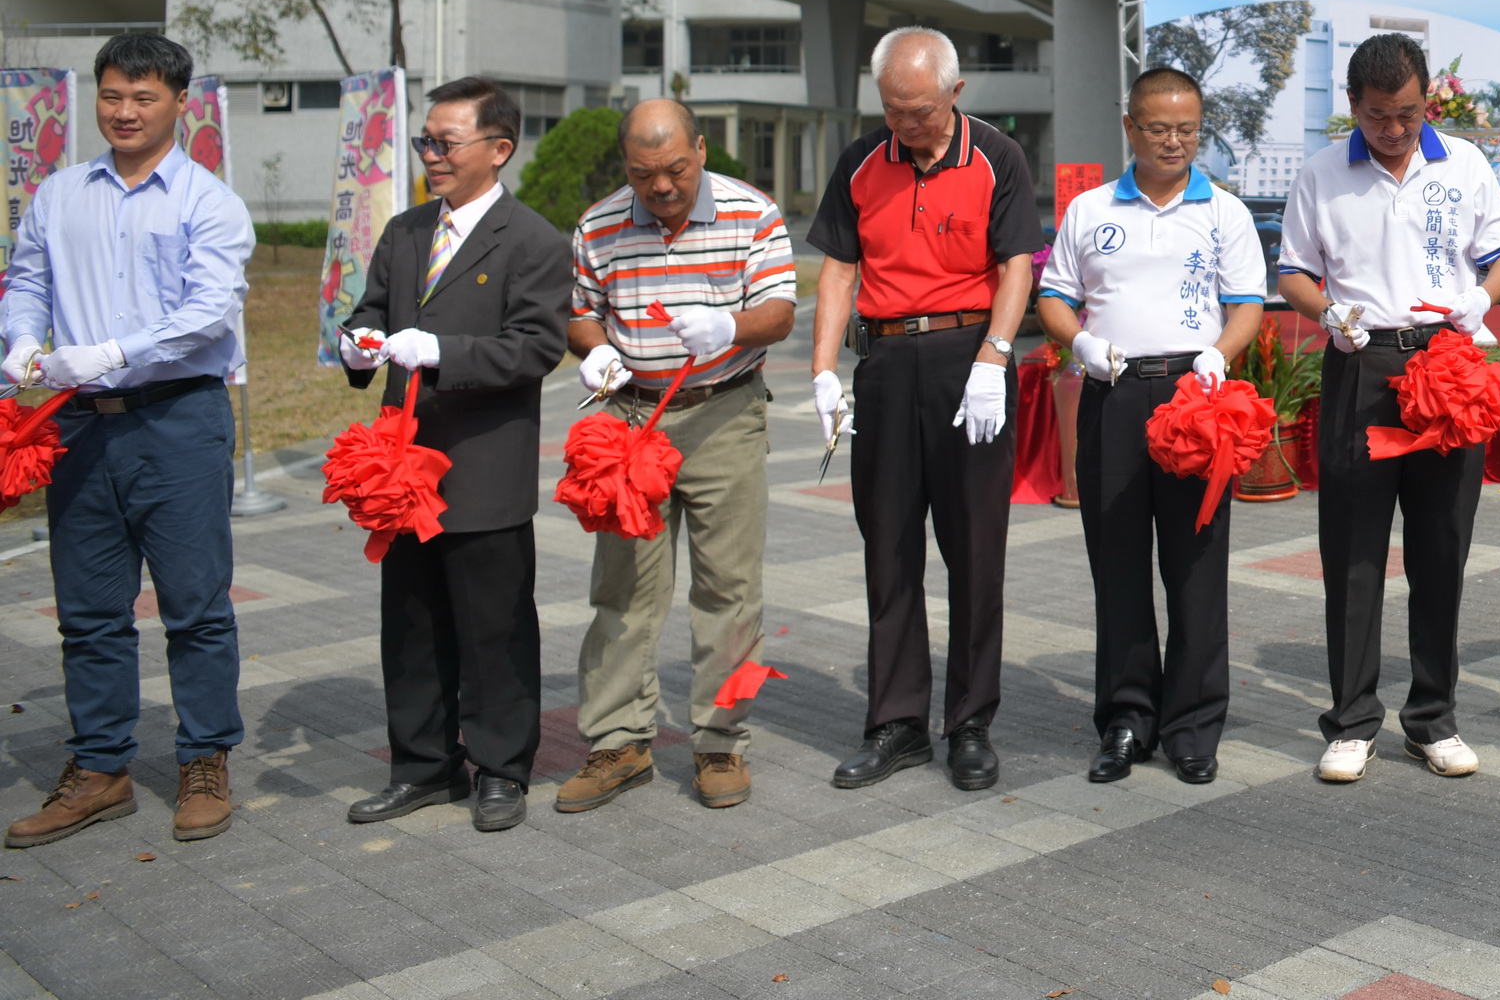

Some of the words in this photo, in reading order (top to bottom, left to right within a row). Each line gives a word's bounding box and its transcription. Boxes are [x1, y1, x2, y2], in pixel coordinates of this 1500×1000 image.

[1423, 208, 1444, 288] 簡景賢
[1445, 206, 1460, 276] 草屯鎮長候選人
[1180, 249, 1206, 330] 李洲忠
